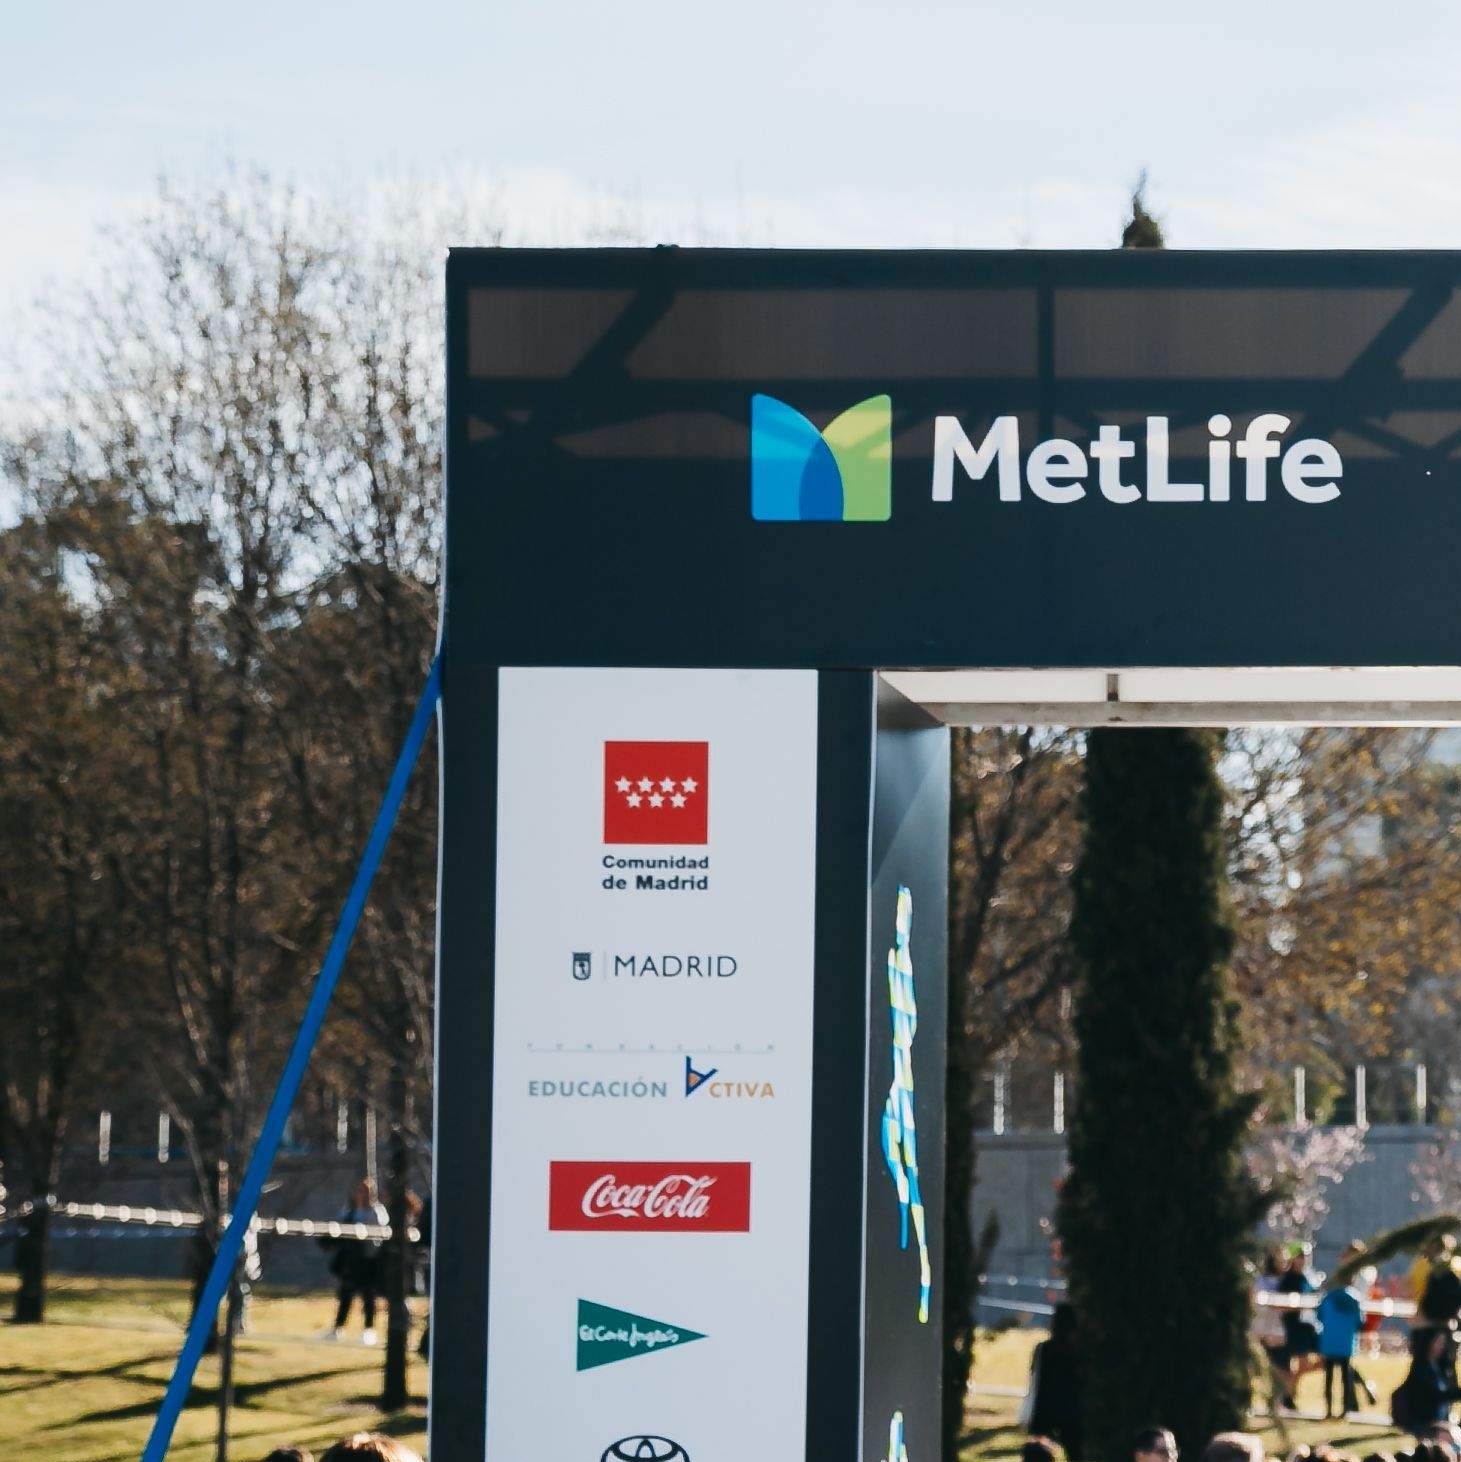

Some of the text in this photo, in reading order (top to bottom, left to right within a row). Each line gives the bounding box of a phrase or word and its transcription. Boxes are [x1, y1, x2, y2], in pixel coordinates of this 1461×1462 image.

[931, 413, 1343, 504] MetLife
[602, 855, 710, 870] Comunidad
[602, 876, 709, 891] de Madrid
[613, 955, 738, 978] MADRID
[528, 1076, 668, 1098] EDUCACIÓN
